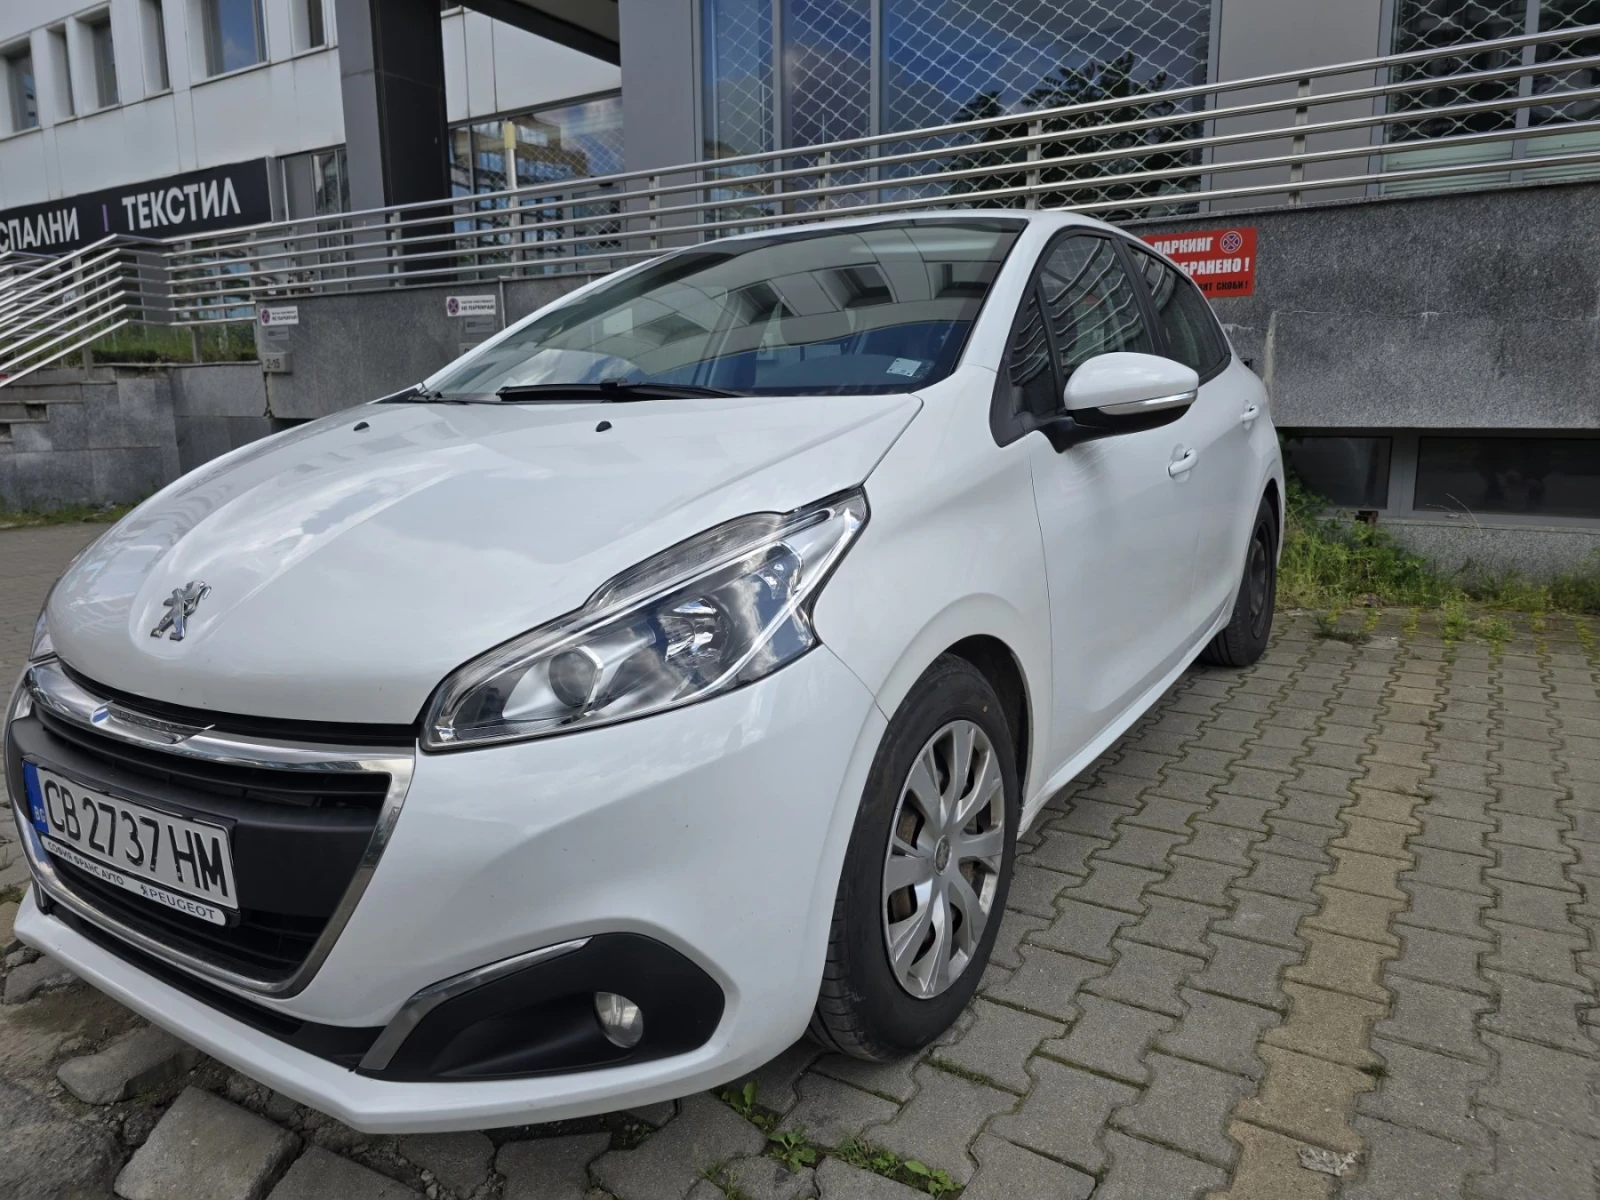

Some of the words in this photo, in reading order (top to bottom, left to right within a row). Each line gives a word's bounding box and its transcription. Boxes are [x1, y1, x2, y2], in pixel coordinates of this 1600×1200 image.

[0, 207, 80, 250] СПАЛНИ
[121, 177, 241, 231] ТЕКСТИЛ
[1177, 258, 1242, 276] БРАНЕНО
[33, 805, 46, 824] BG
[149, 888, 215, 919] PEUGEOT
